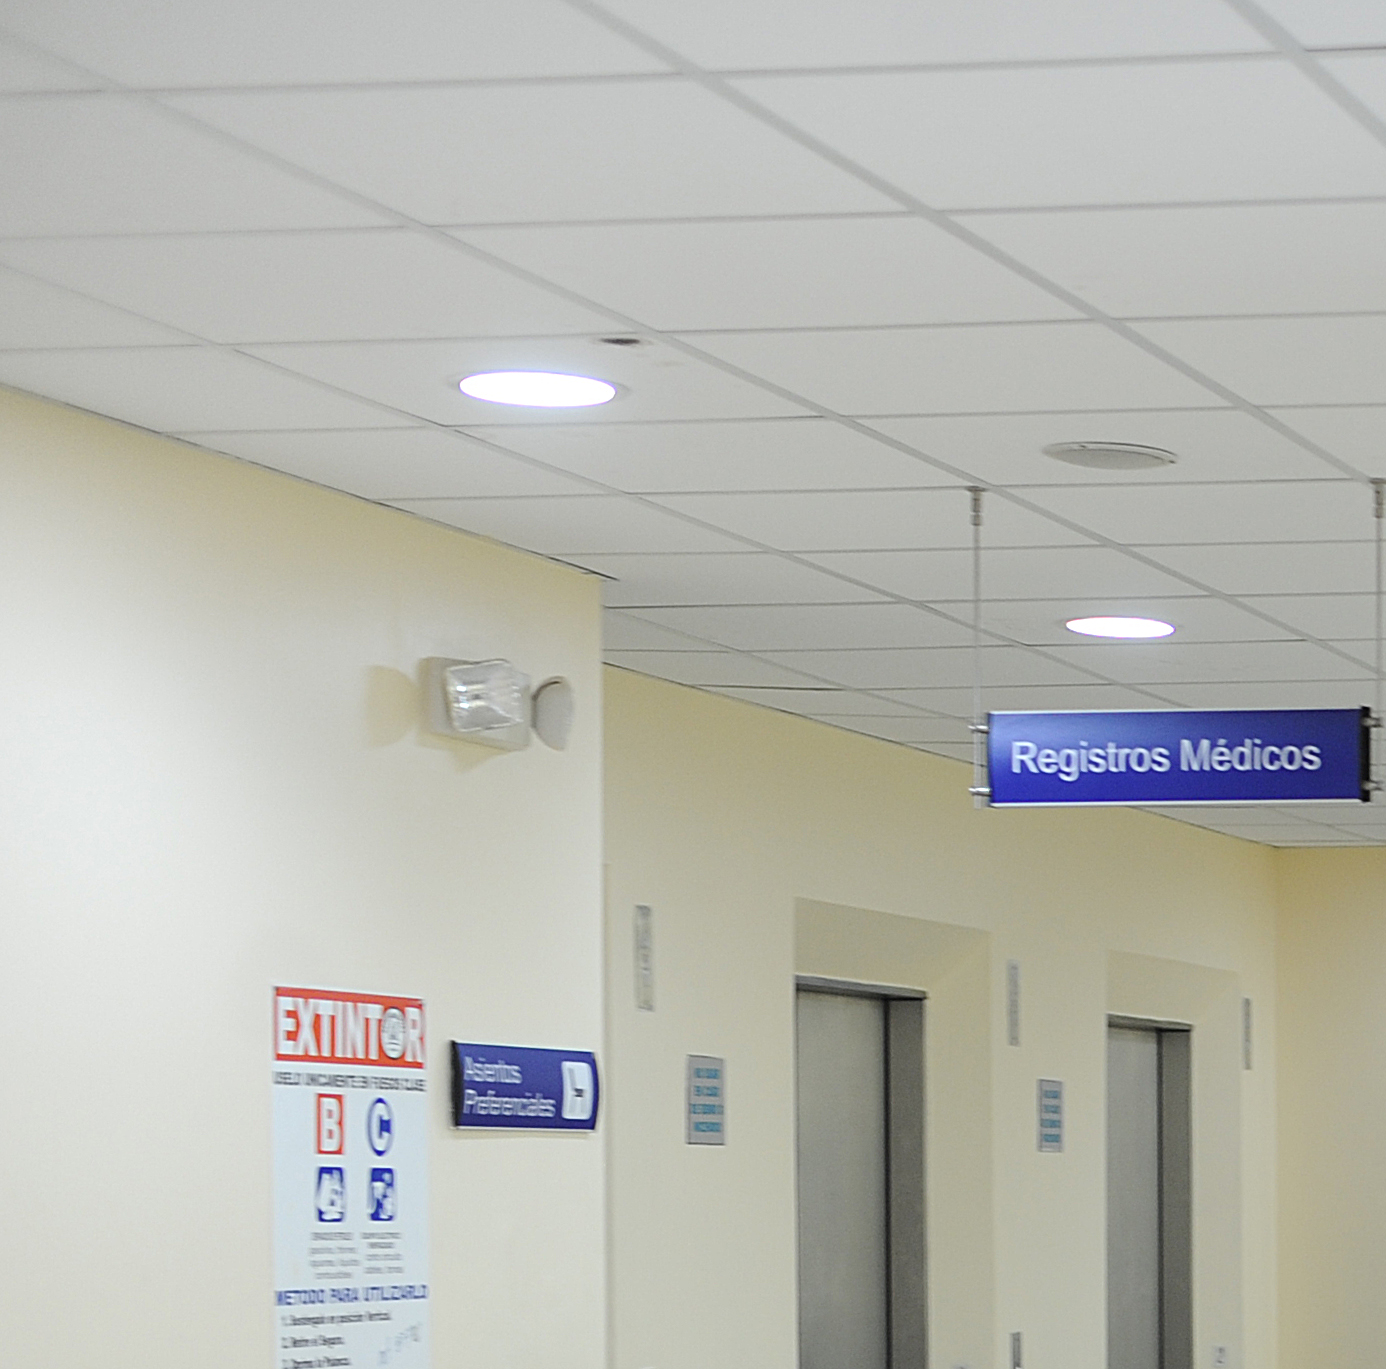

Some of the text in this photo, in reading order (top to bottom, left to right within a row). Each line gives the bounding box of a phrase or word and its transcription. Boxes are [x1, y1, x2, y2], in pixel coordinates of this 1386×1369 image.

[1010, 738, 1322, 782] Registros Médicos
[276, 996, 425, 1063] EXTINTOR
[464, 1055, 523, 1085] Asientos
[316, 1094, 395, 1157] B C
[462, 1089, 556, 1118] Preferenciales
